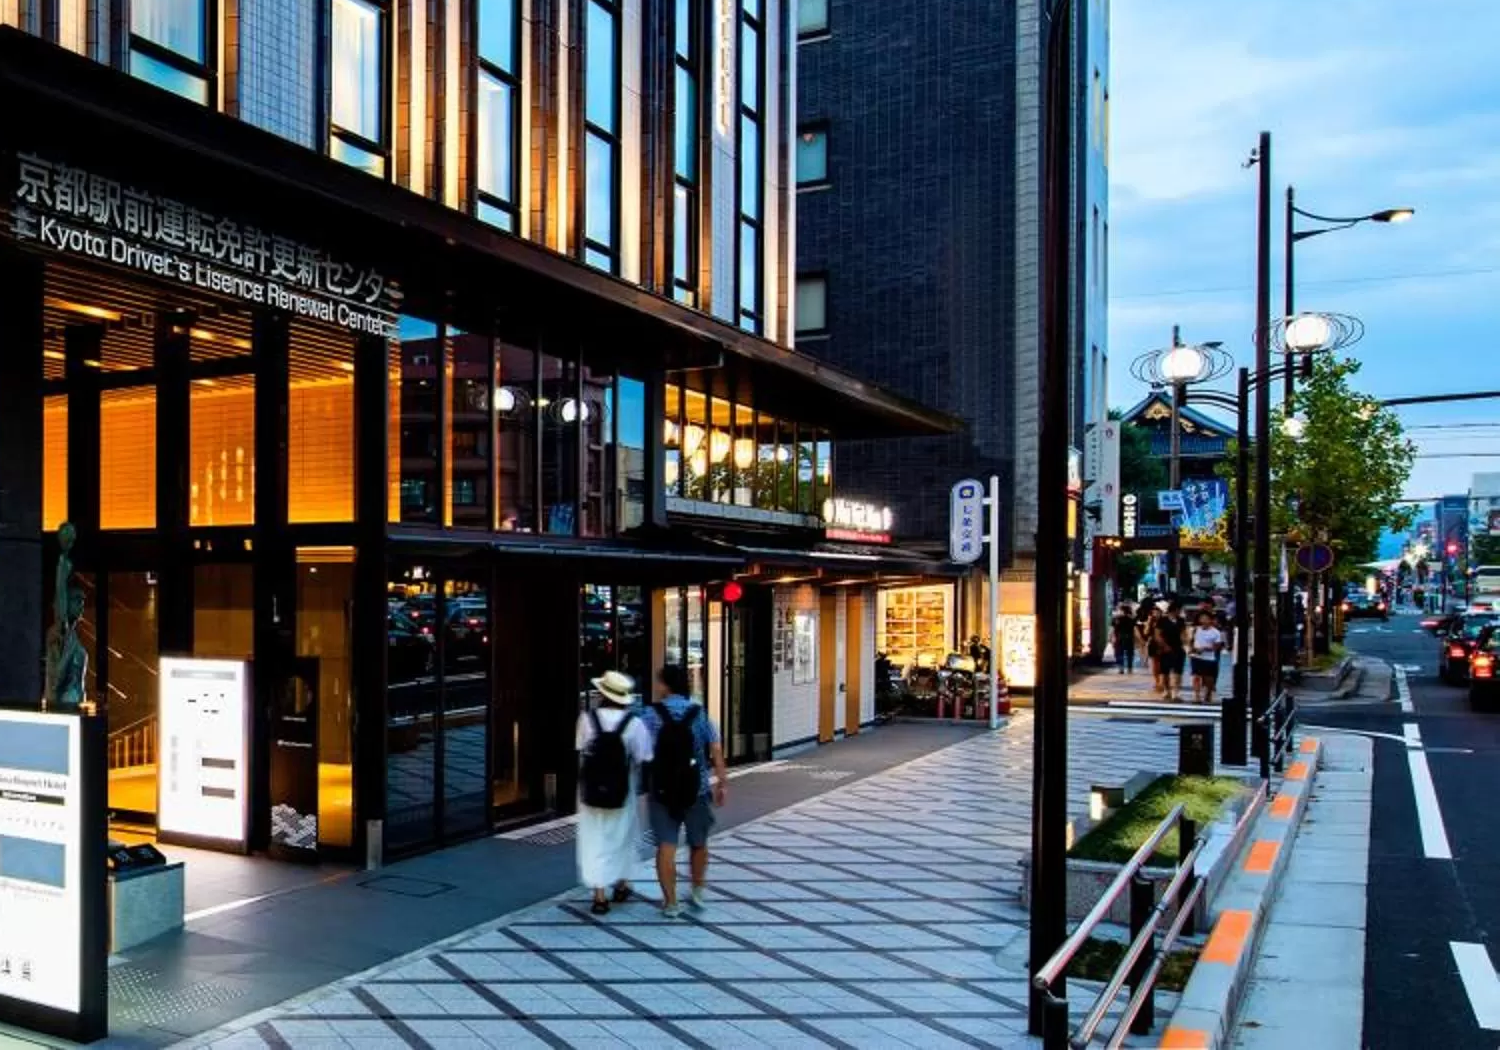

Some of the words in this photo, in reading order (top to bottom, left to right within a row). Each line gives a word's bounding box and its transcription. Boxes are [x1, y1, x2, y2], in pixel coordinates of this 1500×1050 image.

[40, 215, 108, 258] Kyoto
[111, 236, 192, 281] Driver's
[267, 282, 334, 321] Renewal
